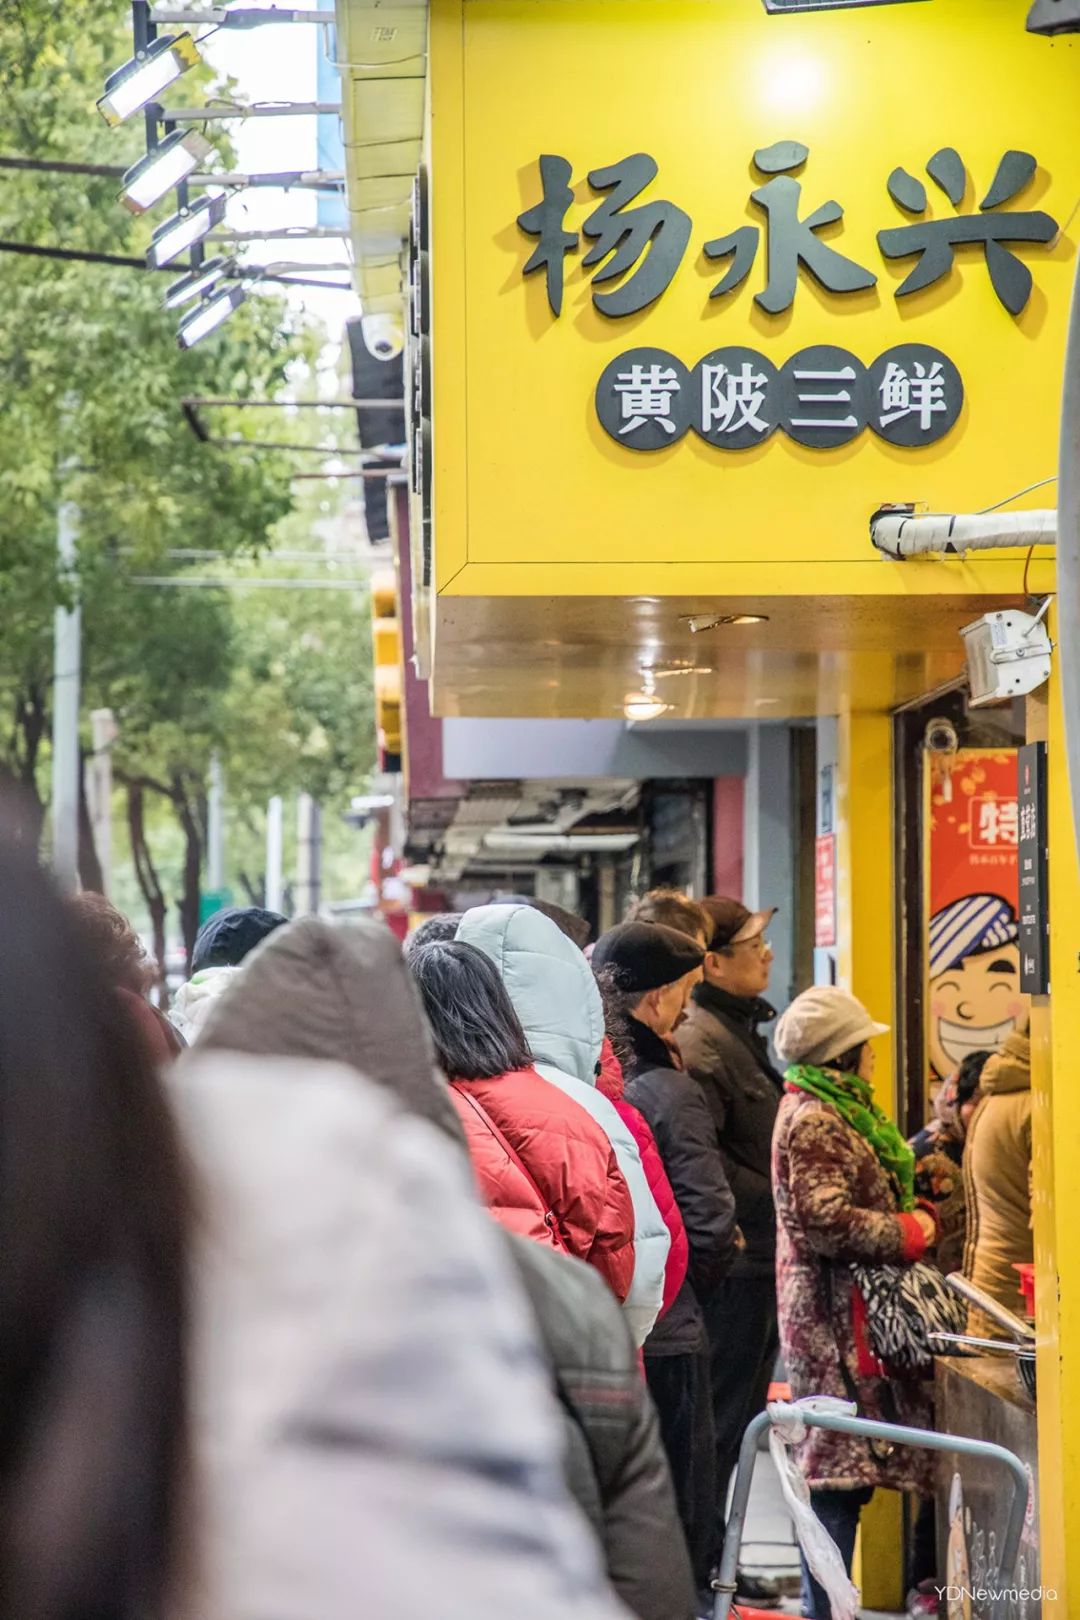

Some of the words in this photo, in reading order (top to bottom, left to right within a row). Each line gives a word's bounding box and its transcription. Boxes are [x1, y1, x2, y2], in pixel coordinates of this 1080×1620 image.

[517, 140, 1059, 317] 杨永兴
[613, 361, 947, 435] 黄陂三鲜
